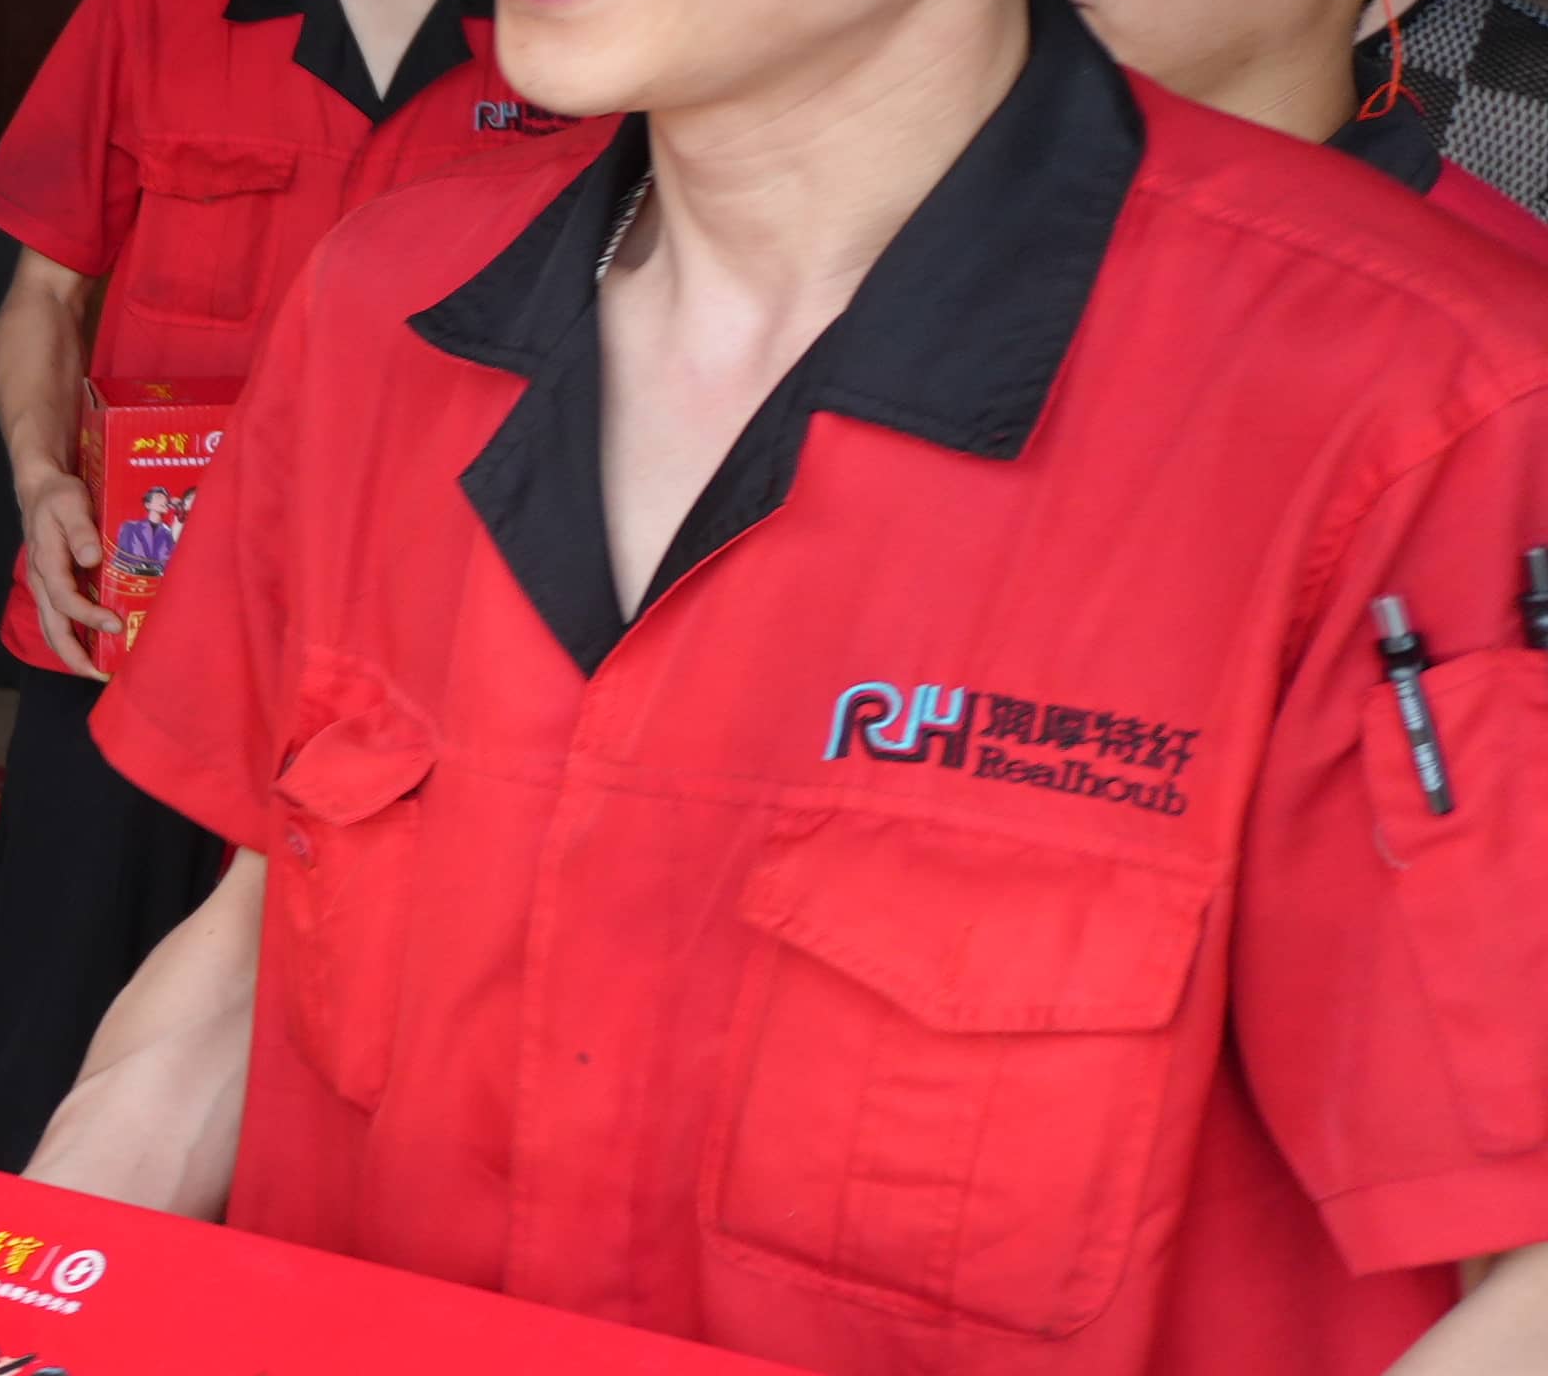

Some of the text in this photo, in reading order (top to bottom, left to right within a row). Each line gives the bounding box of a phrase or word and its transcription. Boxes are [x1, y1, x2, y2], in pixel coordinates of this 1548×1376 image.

[821, 680, 978, 771] RH
[981, 691, 1201, 776] 润厚特纤
[972, 744, 1190, 818] Realhoub
